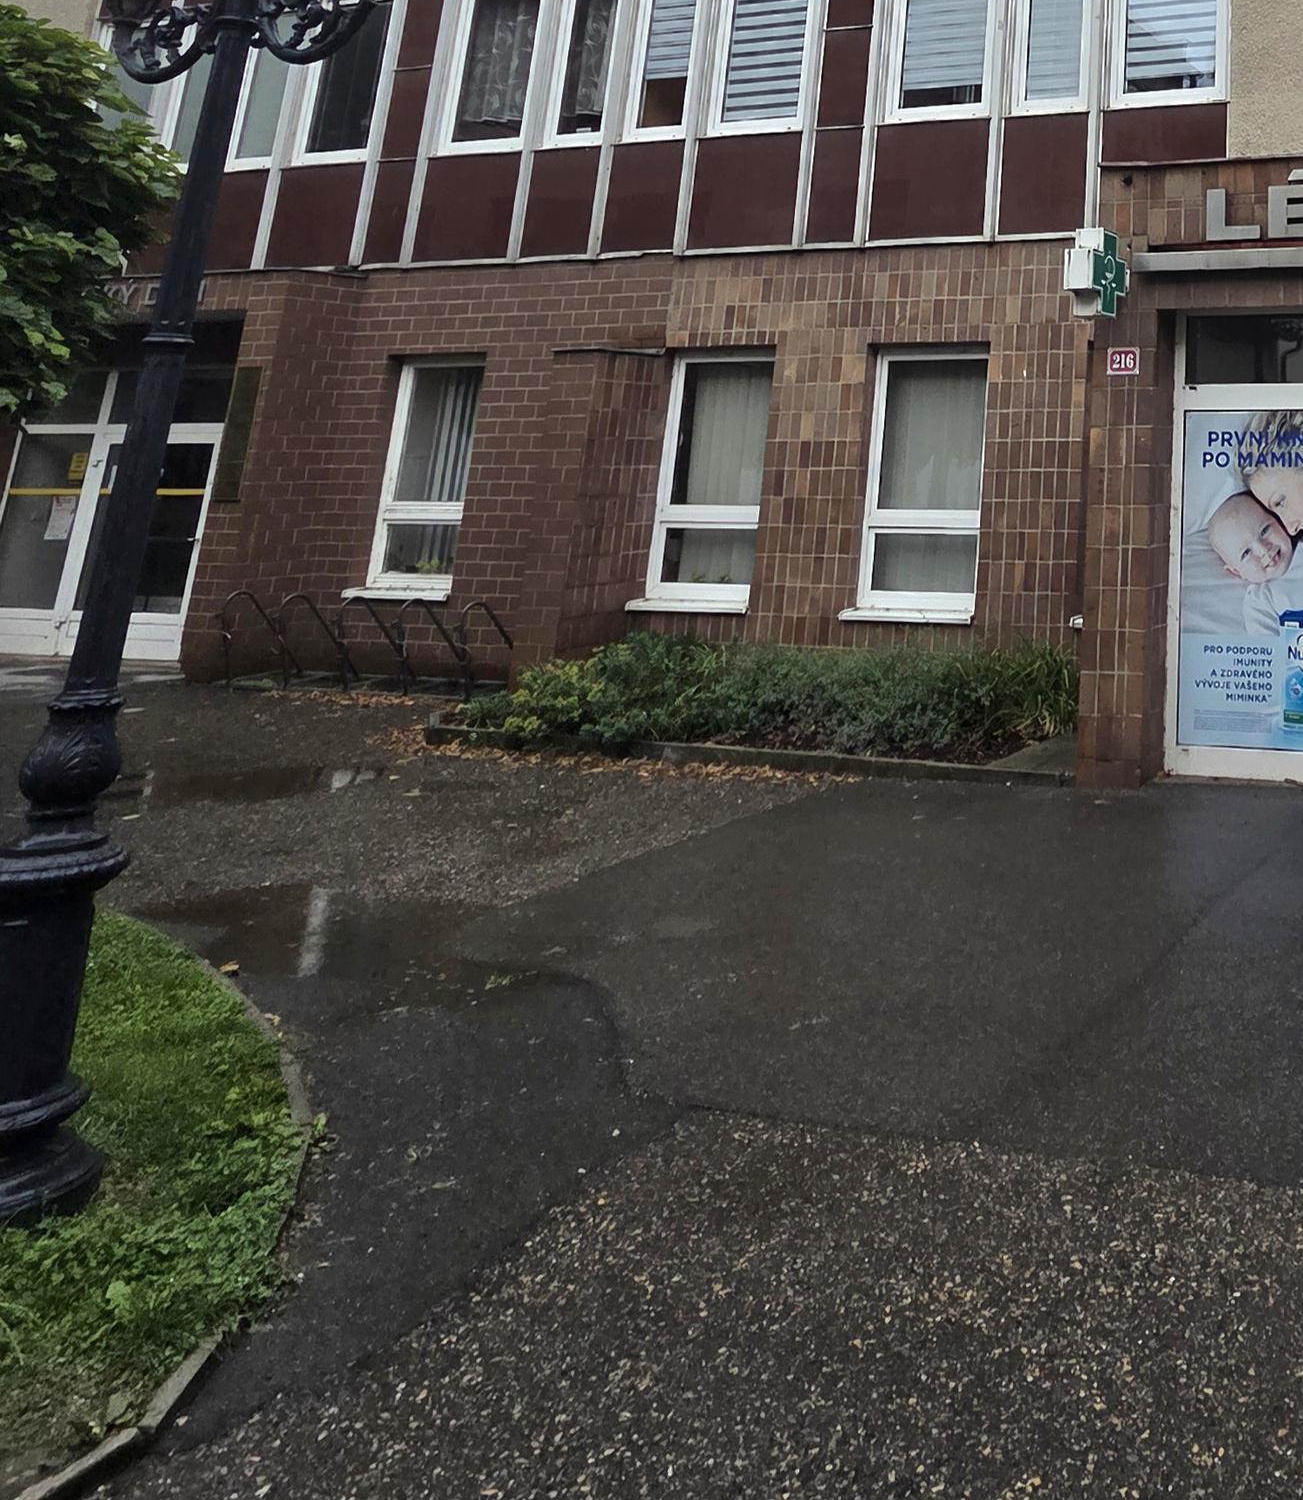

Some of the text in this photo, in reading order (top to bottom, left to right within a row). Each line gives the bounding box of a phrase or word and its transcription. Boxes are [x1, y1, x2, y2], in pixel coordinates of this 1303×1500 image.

[1112, 353, 1134, 369] 216
[1202, 451, 1231, 469] PO
[1203, 644, 1273, 656] PRO PODPORU
[1233, 658, 1273, 668] IMUNITY
[1210, 668, 1273, 679] A ZDRAVÉHO
[1194, 678, 1273, 691] VÝVOJE VAŠEHO
